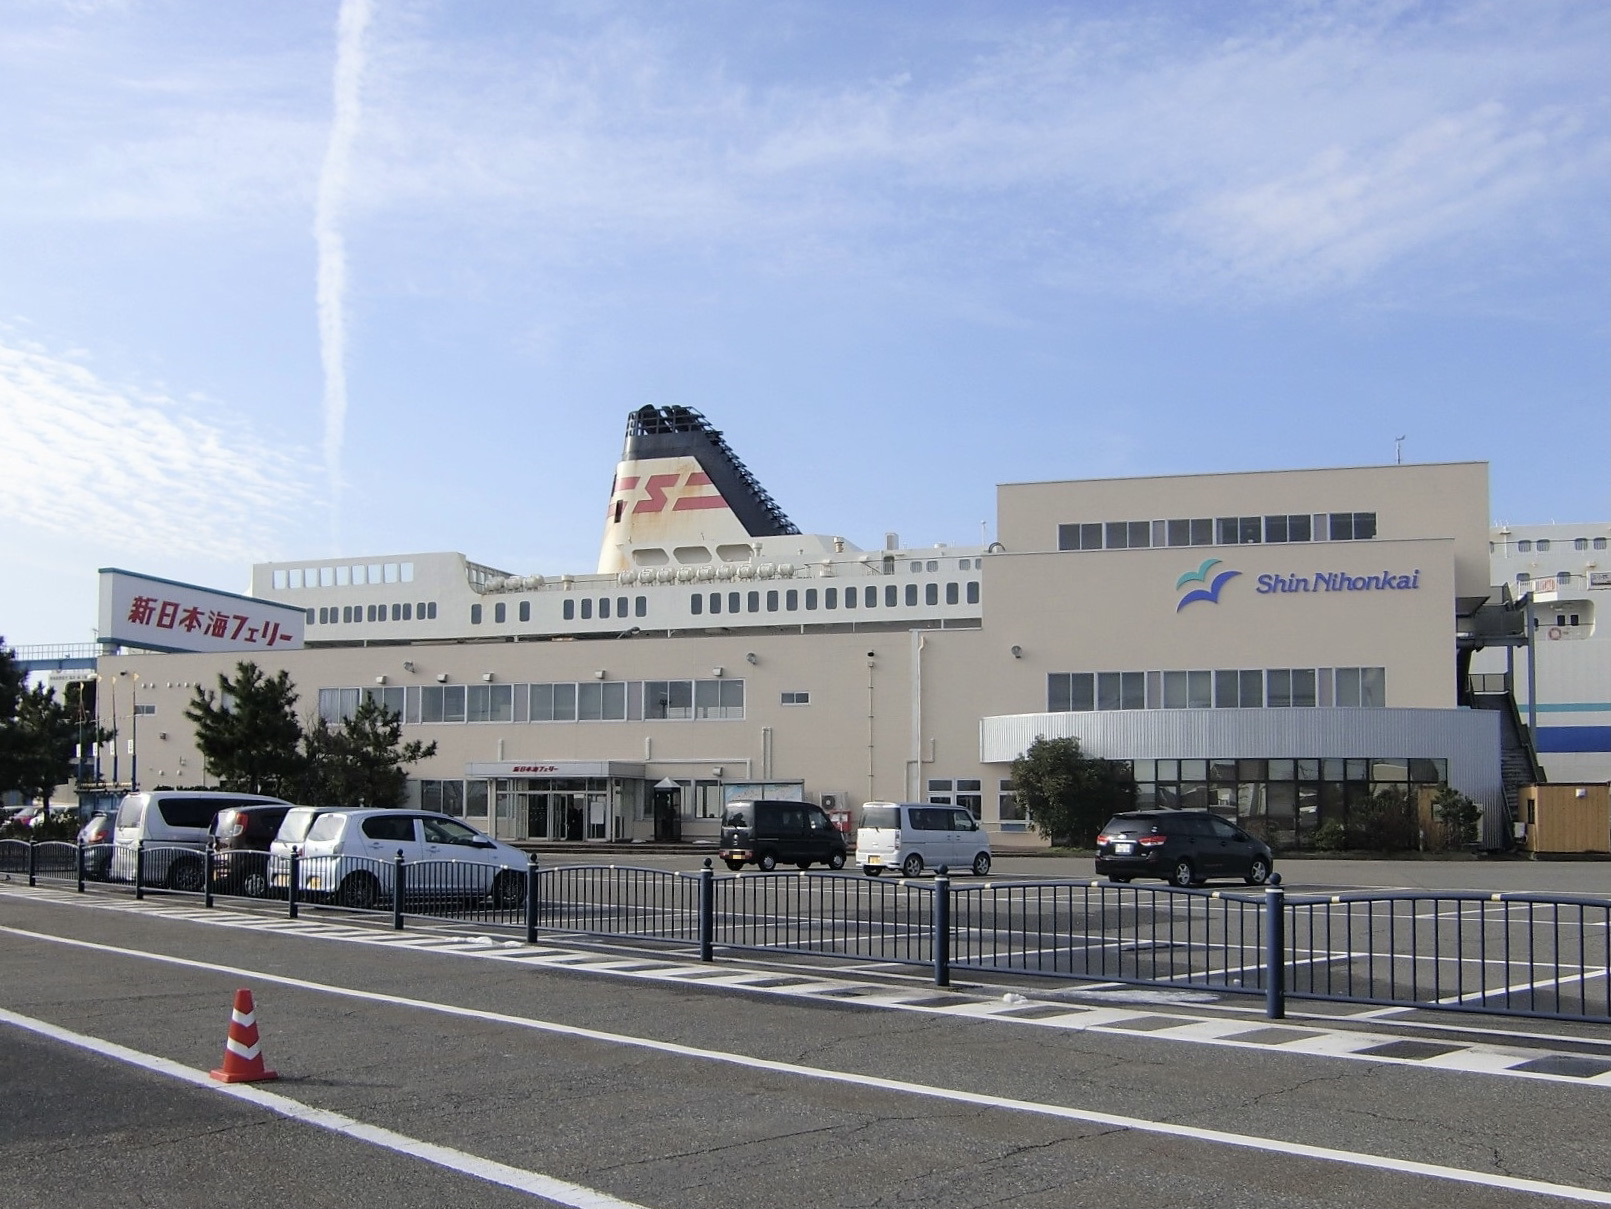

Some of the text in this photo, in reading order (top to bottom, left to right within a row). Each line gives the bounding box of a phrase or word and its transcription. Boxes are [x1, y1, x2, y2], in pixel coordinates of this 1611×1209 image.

[1256, 569, 1419, 594] Shin Nihonkai
[128, 595, 293, 646] 新日本海フェリー
